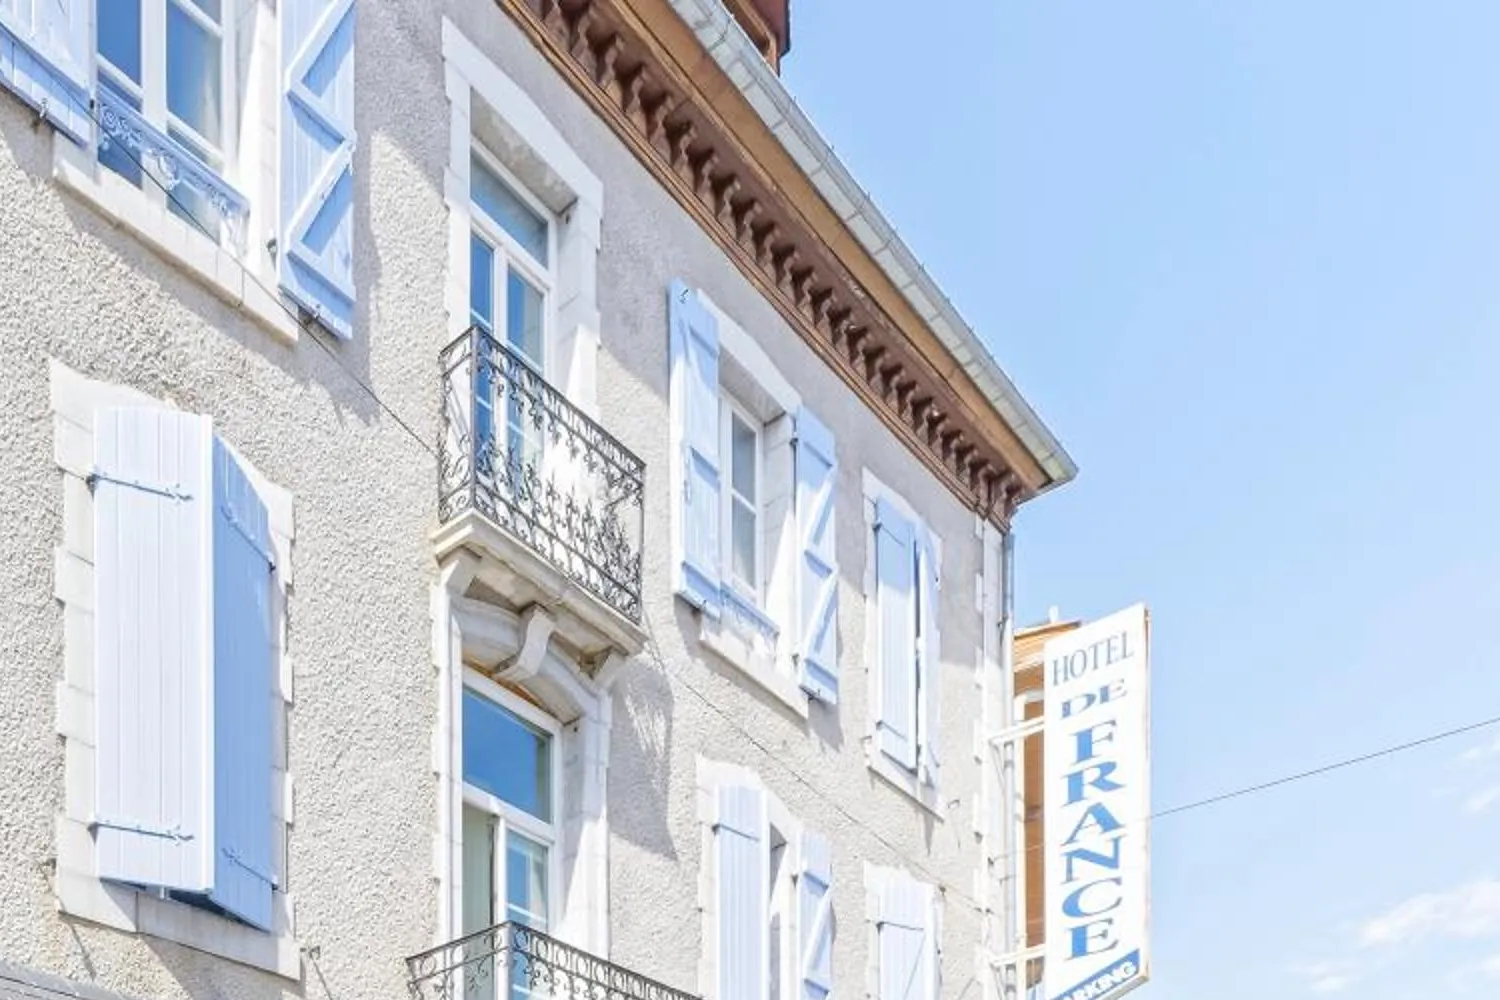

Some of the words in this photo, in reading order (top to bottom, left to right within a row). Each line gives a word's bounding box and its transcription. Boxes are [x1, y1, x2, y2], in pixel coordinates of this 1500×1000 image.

[1051, 632, 1135, 687] HOTEL
[1062, 679, 1128, 718] DE
[1060, 720, 1127, 960] FRANCE
